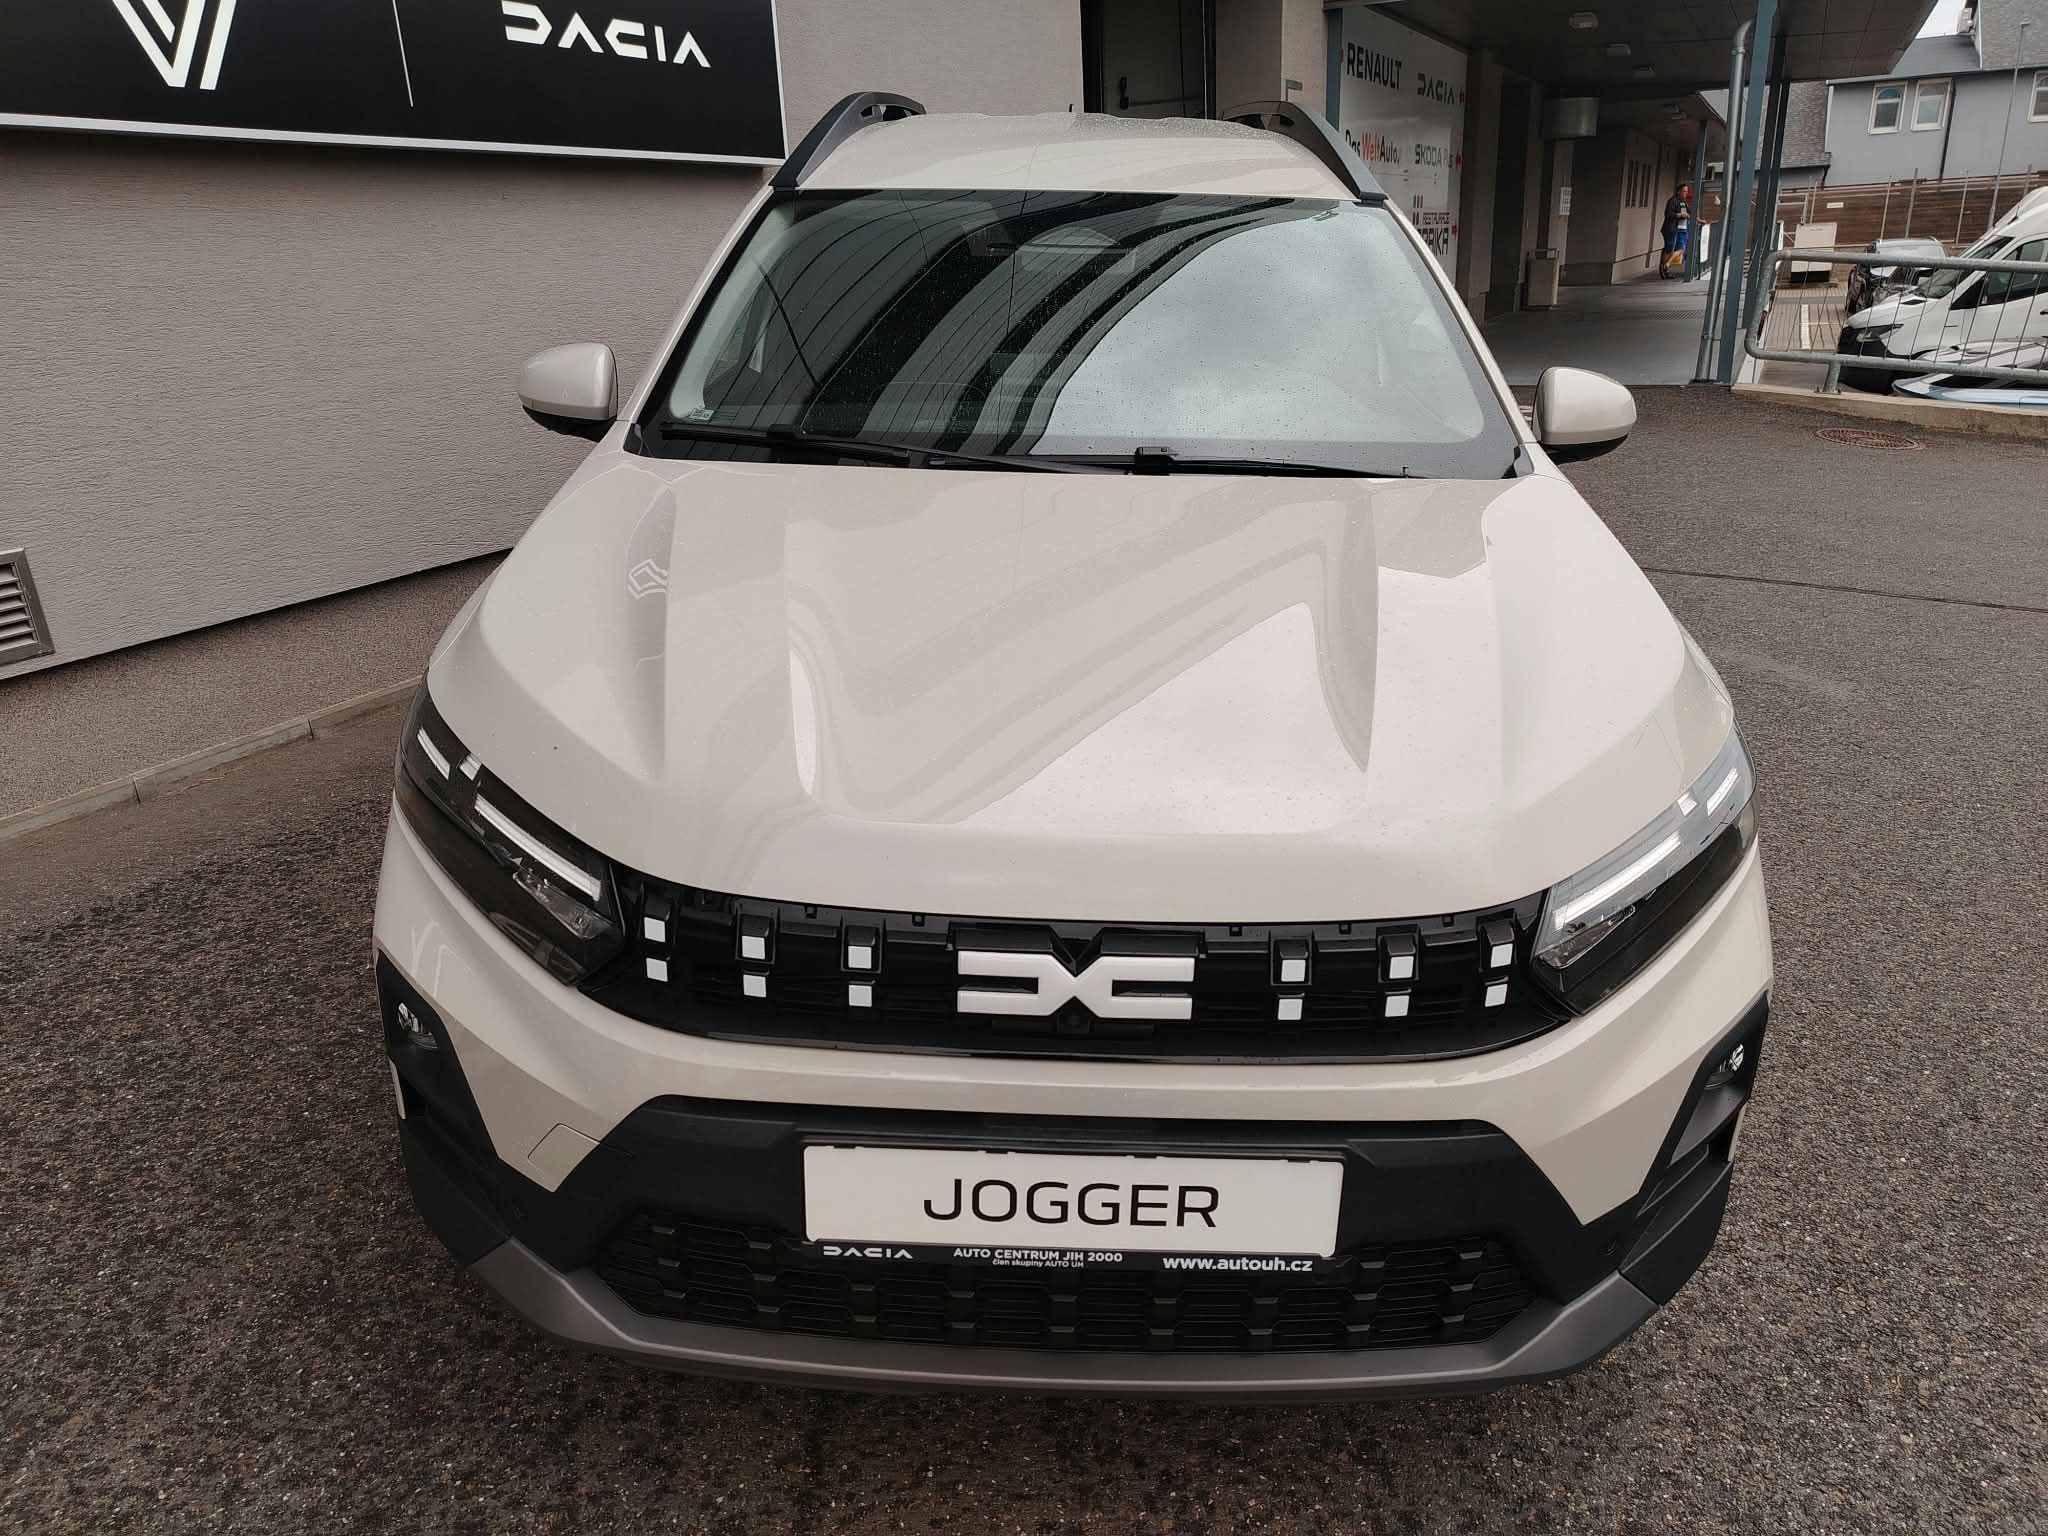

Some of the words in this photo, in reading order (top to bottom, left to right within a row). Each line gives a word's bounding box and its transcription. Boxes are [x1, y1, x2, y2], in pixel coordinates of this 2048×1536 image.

[501, 0, 711, 68] DACIA
[1347, 42, 1402, 90] RENAULT
[1417, 72, 1455, 105] DACIA
[923, 1178, 1219, 1227] JOGGER
[823, 1245, 913, 1259] DACIA
[953, 1248, 991, 1258] AUTO
[994, 1249, 1059, 1260] CENTRUM
[1062, 1251, 1084, 1261] JIH
[1087, 1252, 1123, 1262] 2000
[1011, 1259, 1043, 1268] skupiny
[1044, 1260, 1069, 1268] AUTO
[1163, 1256, 1313, 1272] www.autouh.cz
